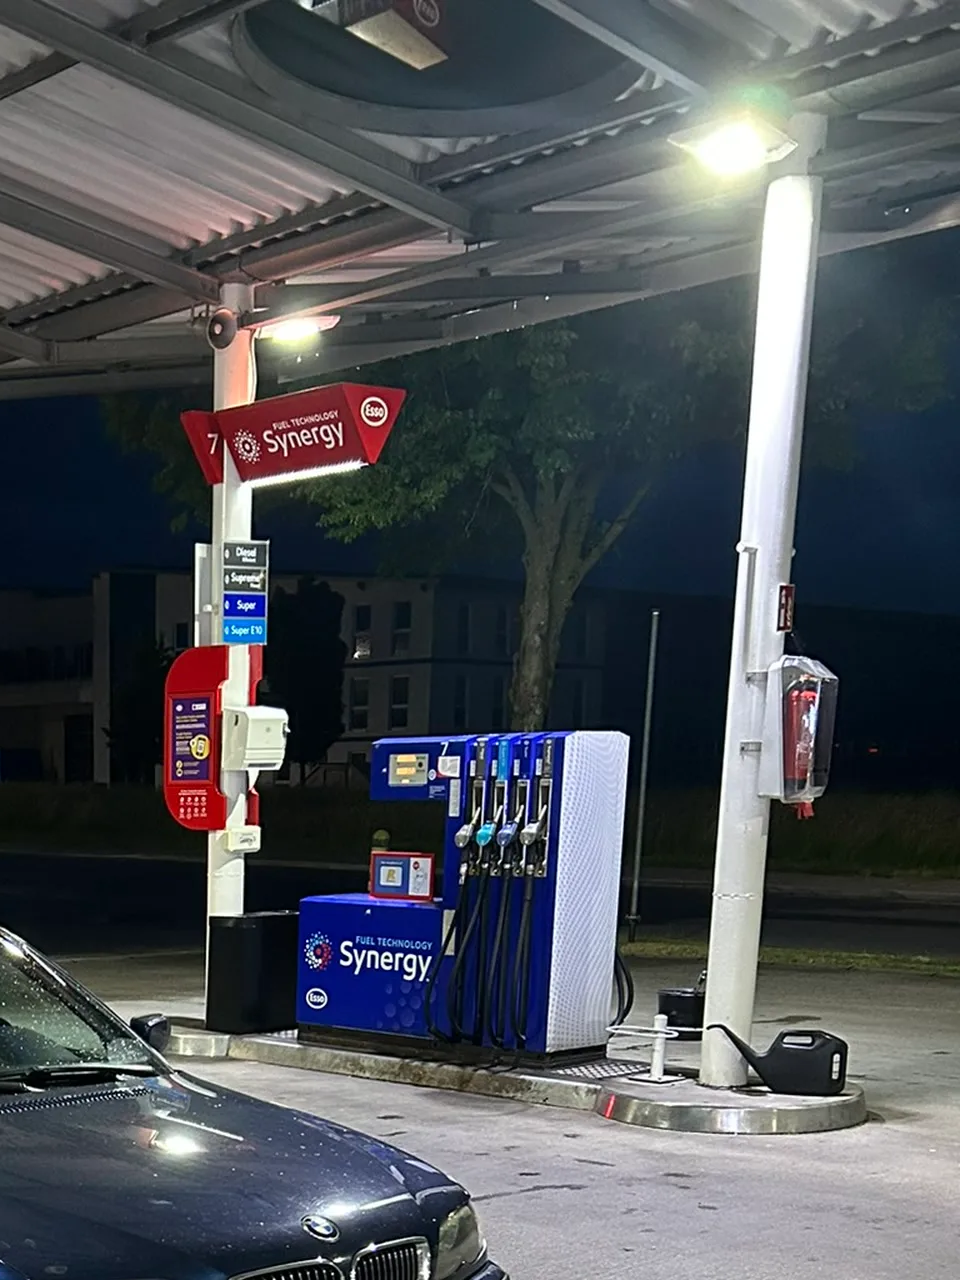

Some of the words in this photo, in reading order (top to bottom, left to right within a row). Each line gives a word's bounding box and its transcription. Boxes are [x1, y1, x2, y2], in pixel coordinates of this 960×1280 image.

[365, 404, 384, 417] Esso
[272, 421, 290, 431] FUEL
[291, 410, 339, 427] TECHNOLOGY
[207, 433, 218, 455] 7
[263, 422, 343, 457] Synergy
[235, 546, 257, 557] Diesel
[236, 600, 257, 612] Super
[231, 625, 250, 637] Super
[251, 625, 263, 636] E10
[440, 741, 449, 756] 7
[355, 936, 375, 946] FUEL
[377, 937, 433, 950] TECHNOLOGY
